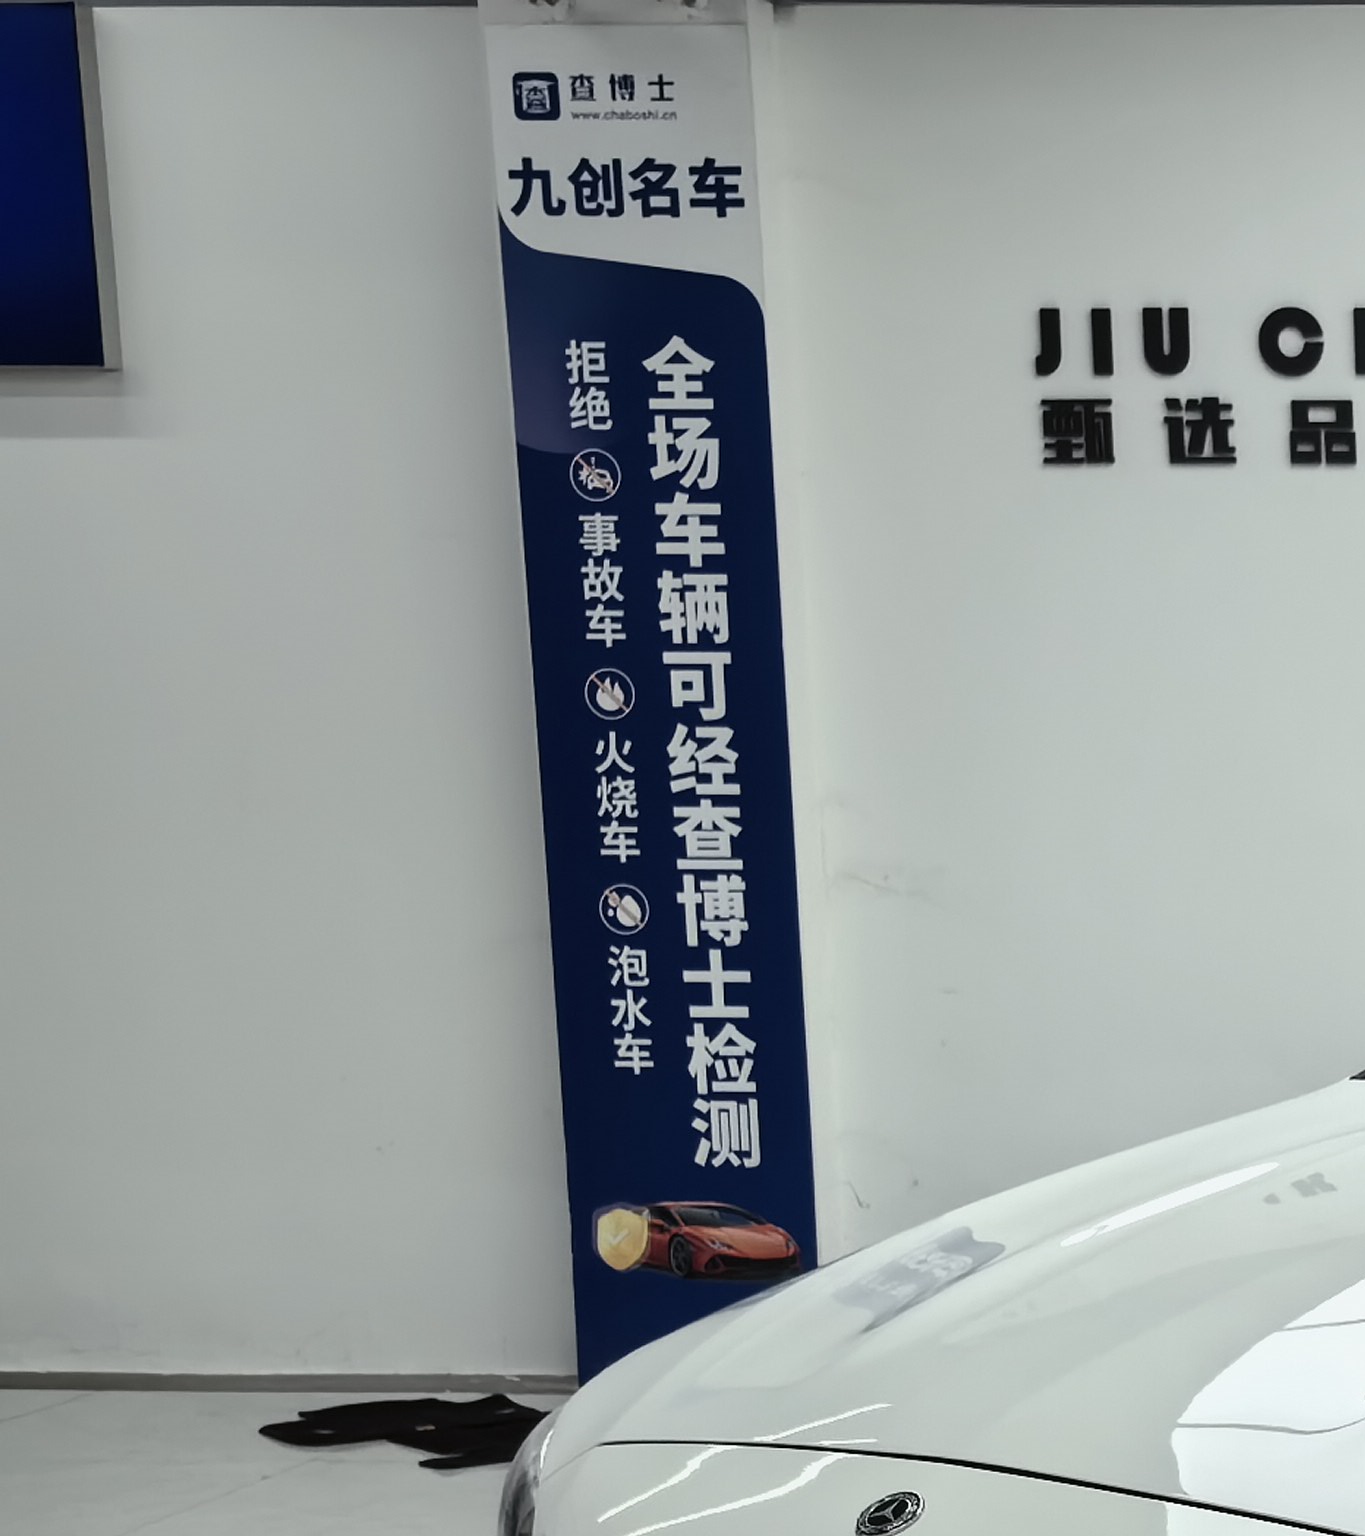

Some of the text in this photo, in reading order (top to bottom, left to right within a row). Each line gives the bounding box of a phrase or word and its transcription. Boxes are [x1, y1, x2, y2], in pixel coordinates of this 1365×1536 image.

[569, 73, 675, 102] 查博士
[570, 109, 678, 121] www.chaboshi.cn
[508, 156, 746, 218] 九创名车
[565, 339, 613, 431] 拒绝
[1035, 306, 1190, 377] JIU
[578, 512, 627, 648] 事故车
[595, 730, 641, 864] 火烧车
[641, 334, 762, 1168] 全场车辆可经查博士检测
[607, 945, 655, 1075] 泡水车
